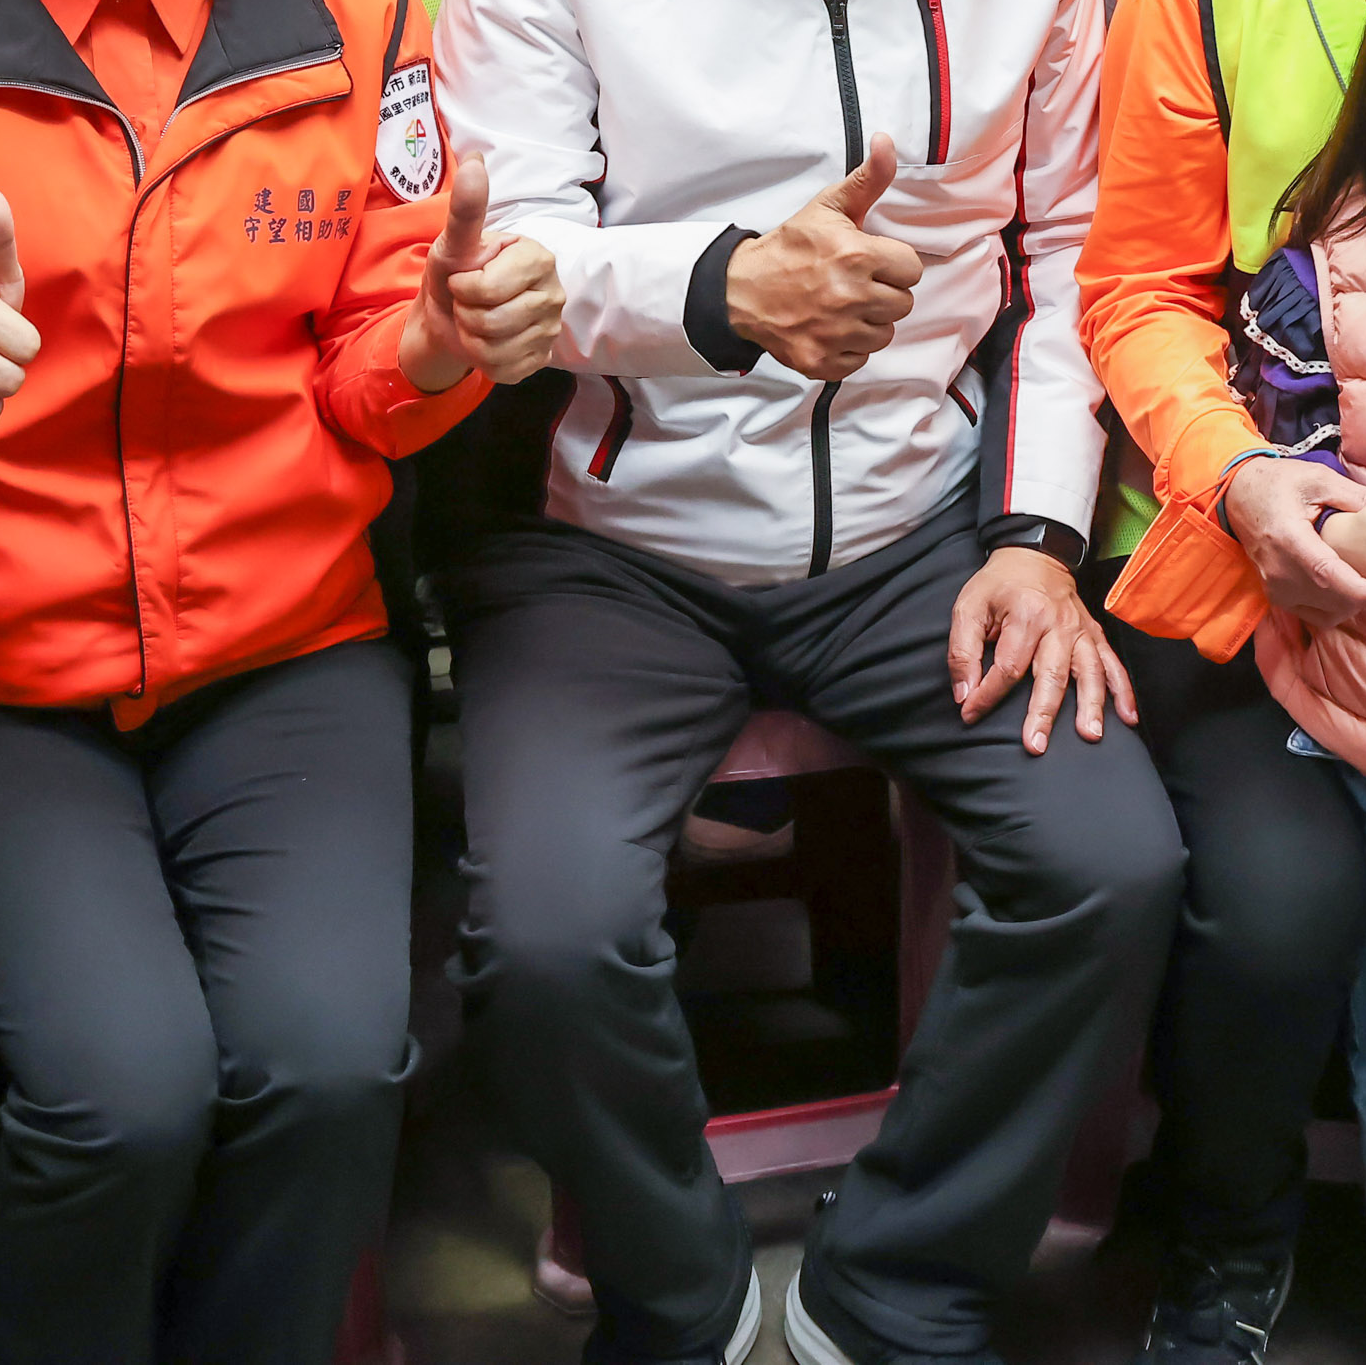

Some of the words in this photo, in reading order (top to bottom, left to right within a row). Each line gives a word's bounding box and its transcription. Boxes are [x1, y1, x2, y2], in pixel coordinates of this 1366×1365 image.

[253, 187, 352, 214] 建國里
[243, 216, 352, 243] 守望相助隊
